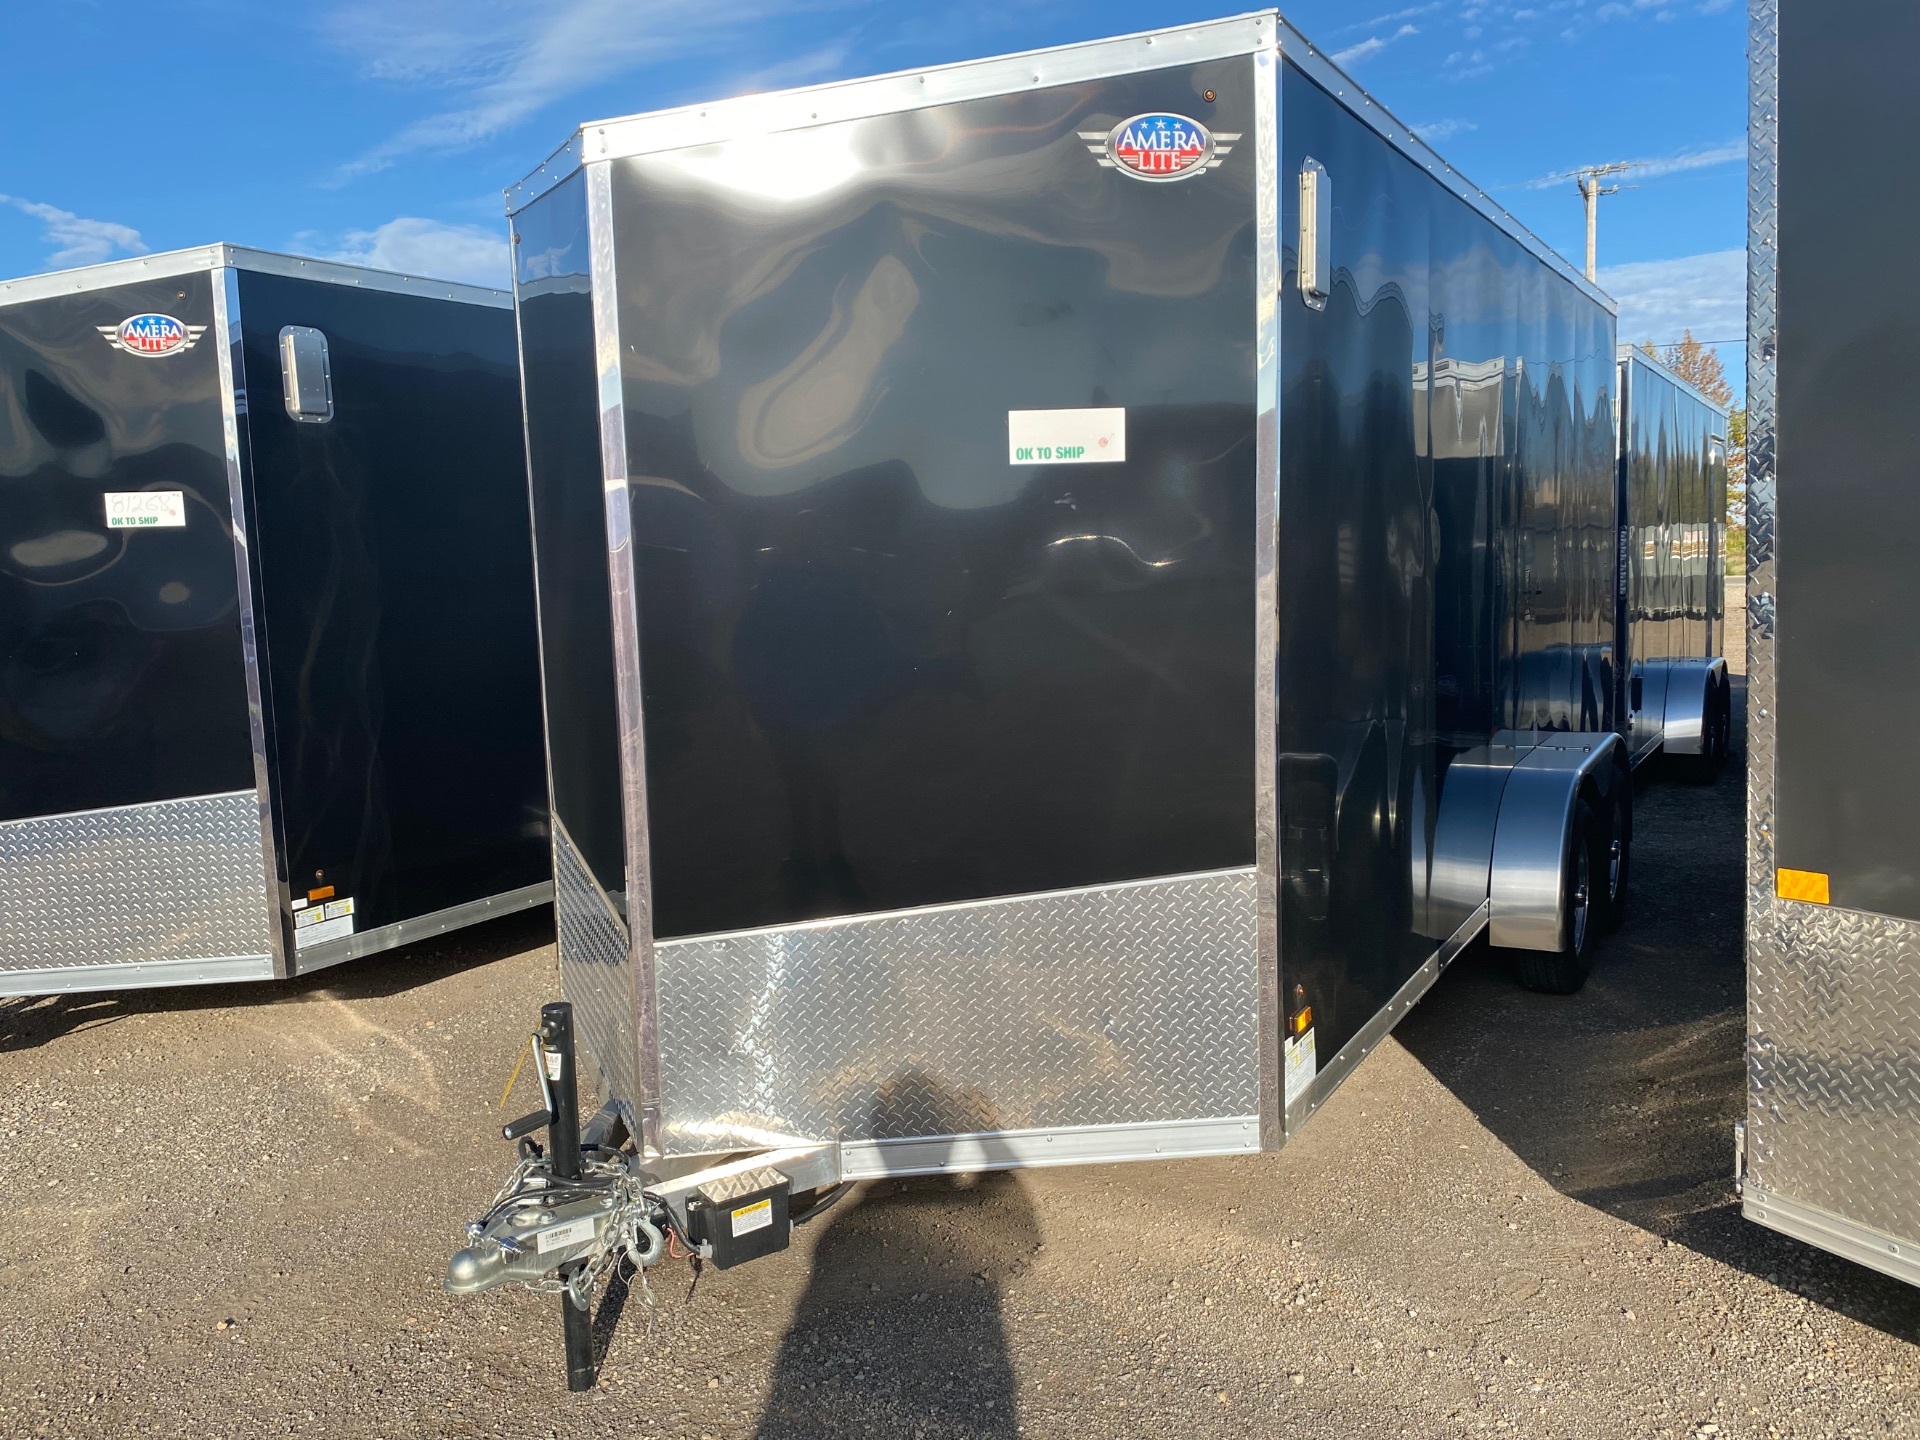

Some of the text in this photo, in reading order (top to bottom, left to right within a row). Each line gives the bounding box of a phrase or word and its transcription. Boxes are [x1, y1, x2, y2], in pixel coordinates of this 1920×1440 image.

[1118, 127, 1204, 151] AMERA
[1138, 151, 1181, 170] LITE
[124, 323, 182, 338] AMERA
[137, 338, 167, 350] LITE
[1015, 446, 1085, 460] OK TO SHIP
[111, 494, 170, 514] 81268
[111, 516, 159, 526] OK TO SHIP
